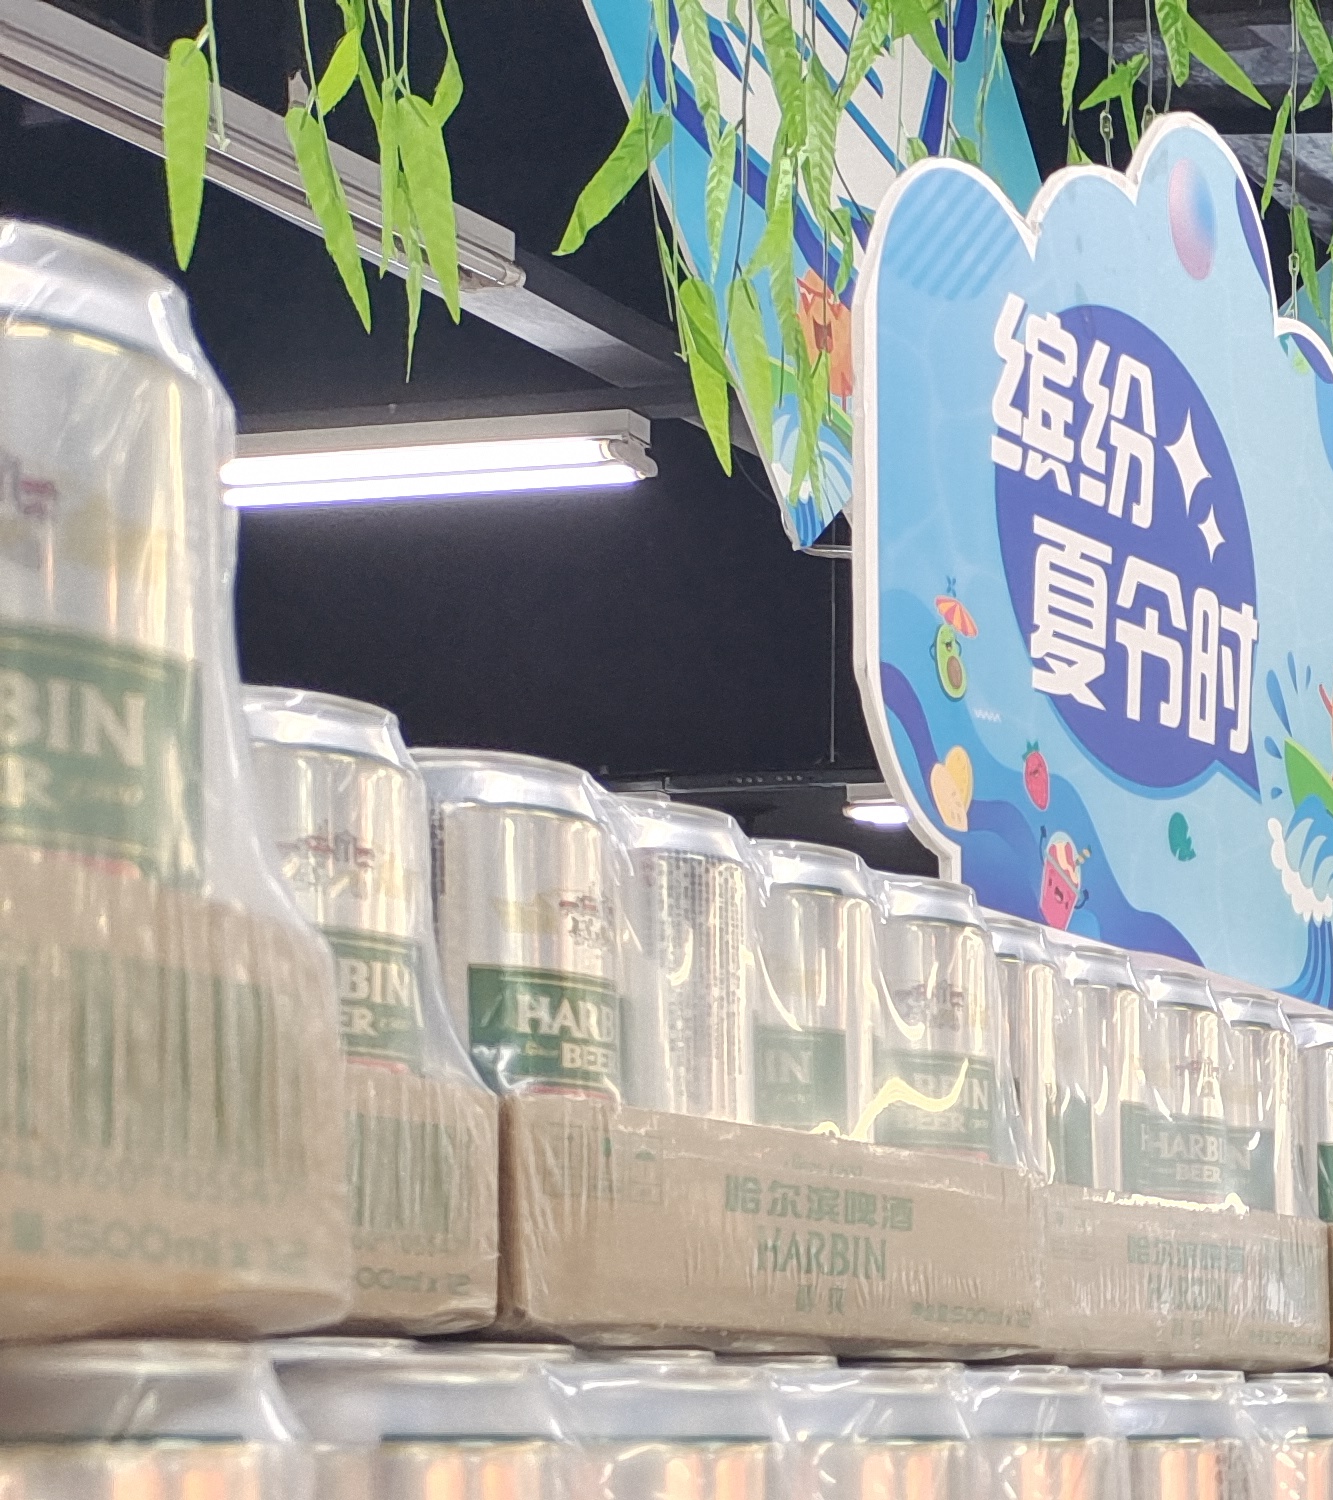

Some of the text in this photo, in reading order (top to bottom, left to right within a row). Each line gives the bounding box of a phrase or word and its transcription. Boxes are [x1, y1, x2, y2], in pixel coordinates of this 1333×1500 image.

[991, 292, 1156, 530] 缤纷
[725, 1173, 914, 1233] 哈尔滨啤酒
[757, 1223, 888, 1281] HARBIN
